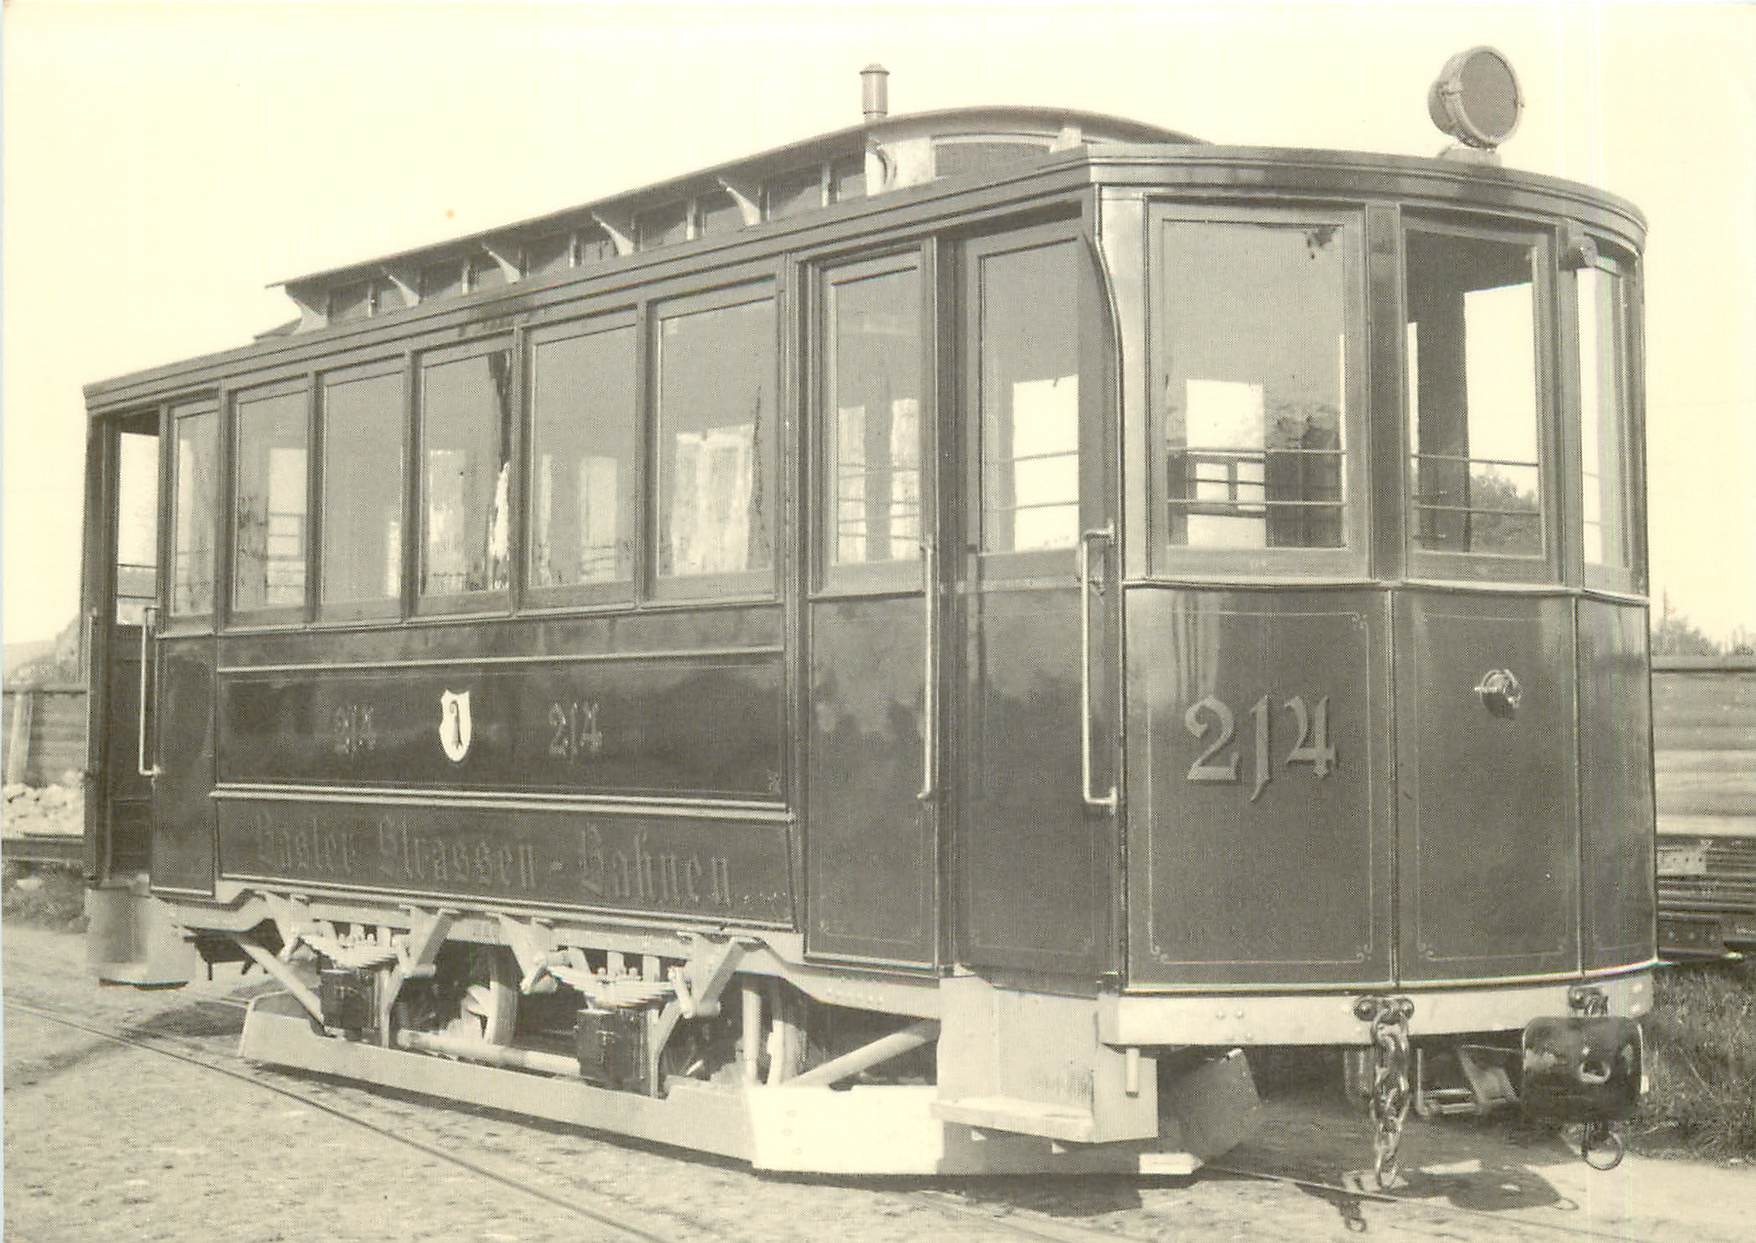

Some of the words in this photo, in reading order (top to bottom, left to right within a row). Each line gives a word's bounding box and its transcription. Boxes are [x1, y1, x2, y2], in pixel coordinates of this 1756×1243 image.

[549, 702, 602, 762] 214
[1184, 694, 1338, 802] 214
[378, 812, 536, 888] Strassen
[579, 820, 731, 906] Bahnen
